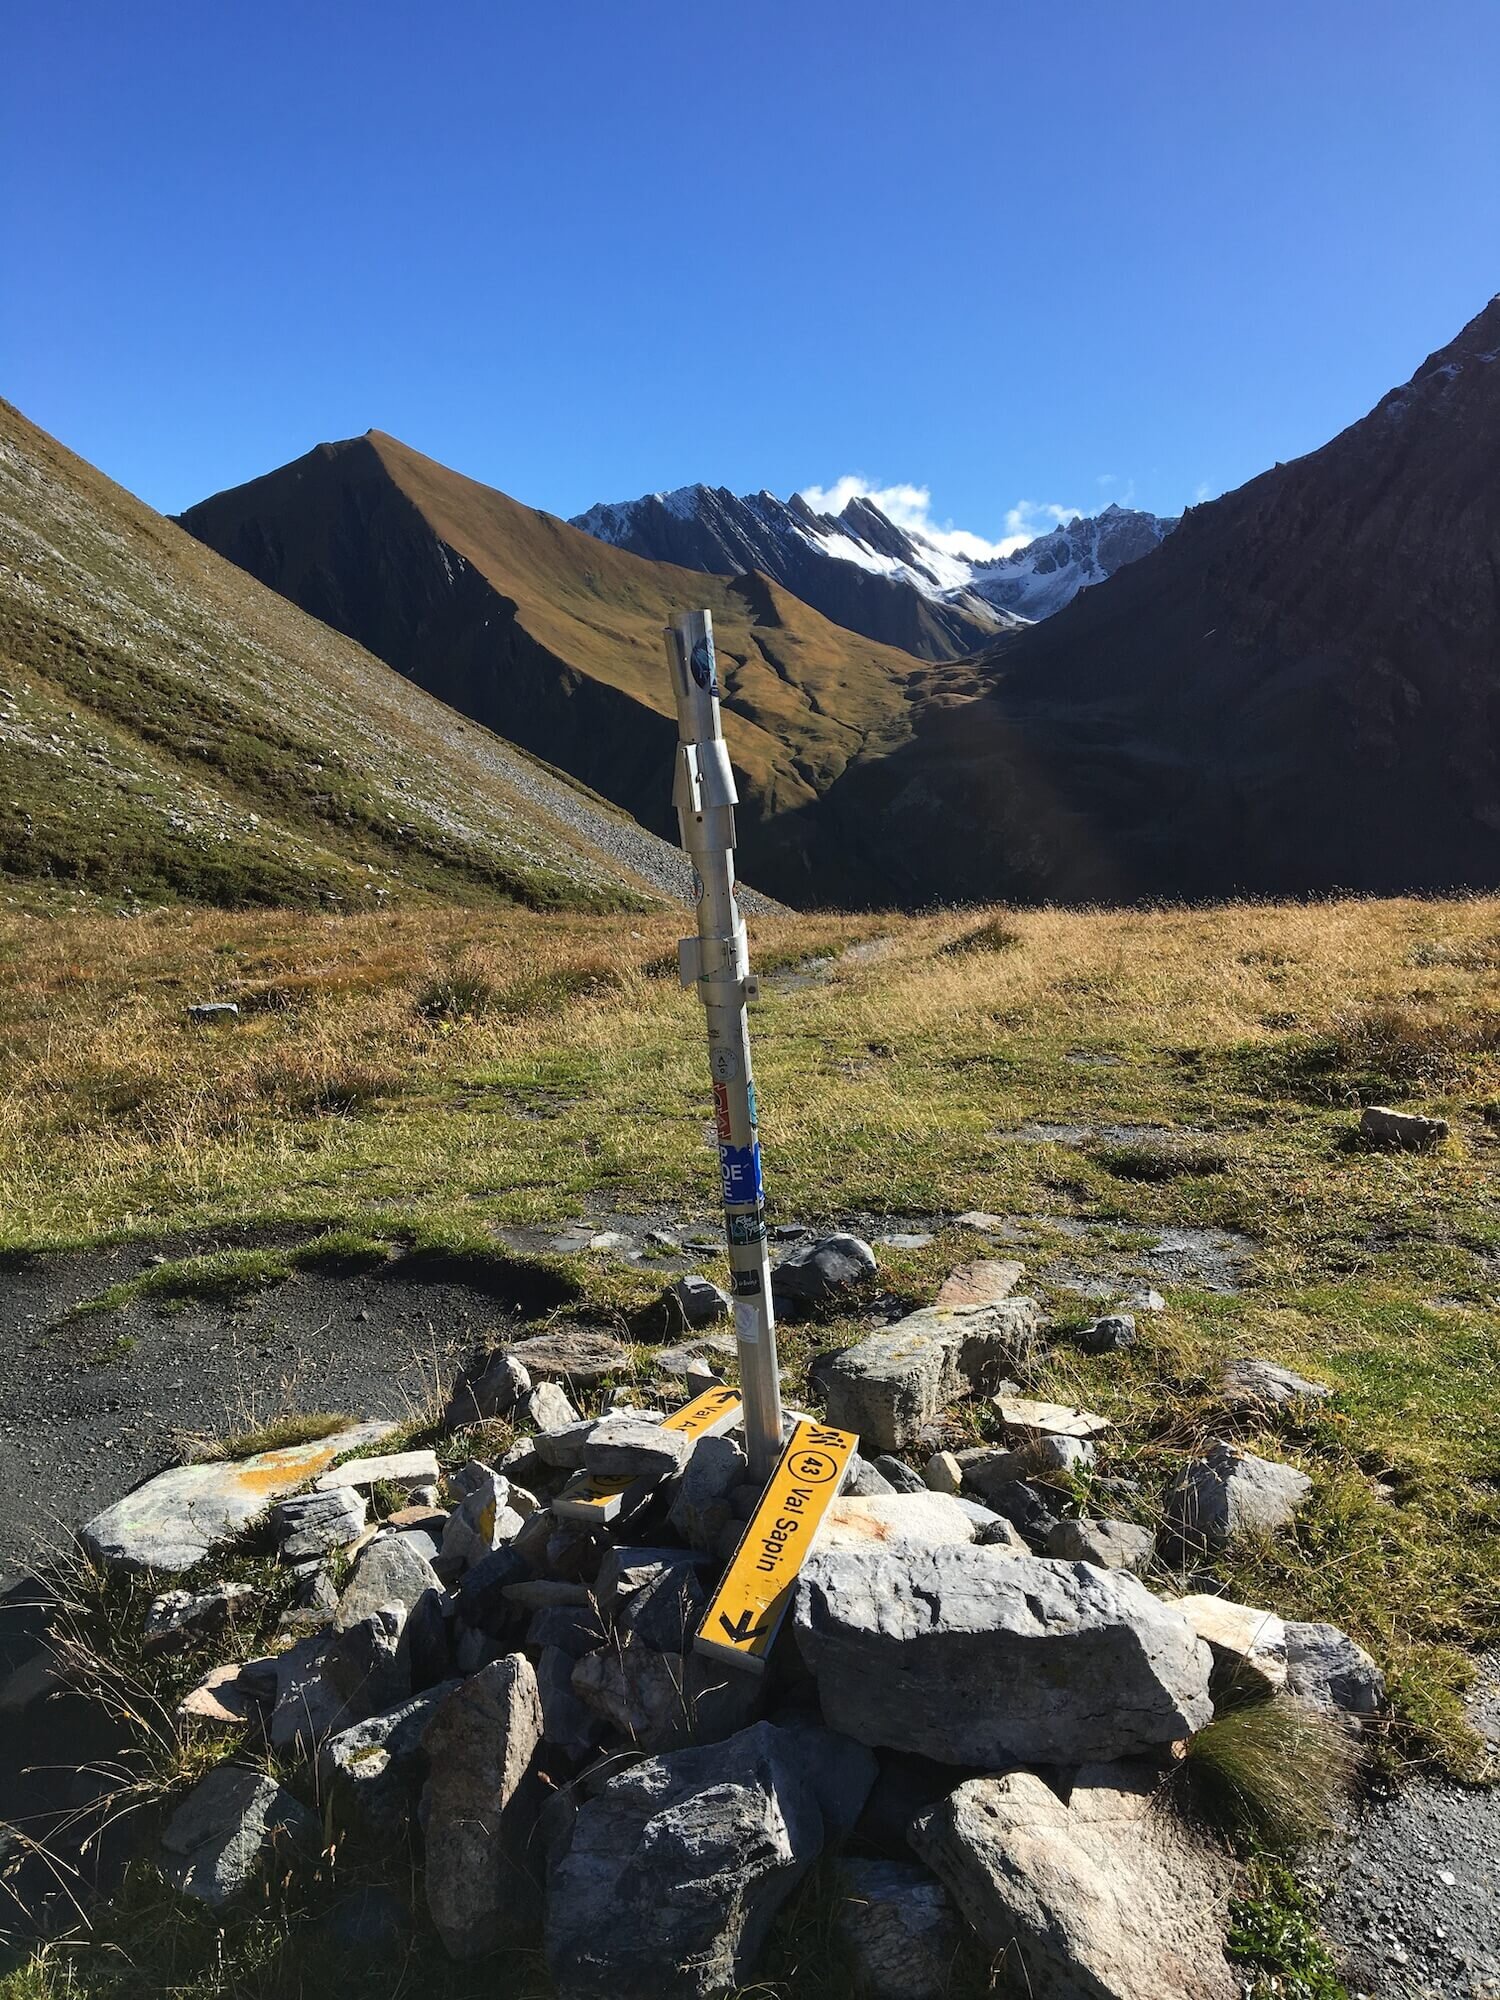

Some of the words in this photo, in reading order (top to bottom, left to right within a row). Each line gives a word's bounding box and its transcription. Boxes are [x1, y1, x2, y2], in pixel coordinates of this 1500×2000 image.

[692, 1406, 723, 1420] Val
[801, 1457, 823, 1475] 43
[783, 1488, 813, 1514] Val
[756, 1517, 799, 1572] Sapin
